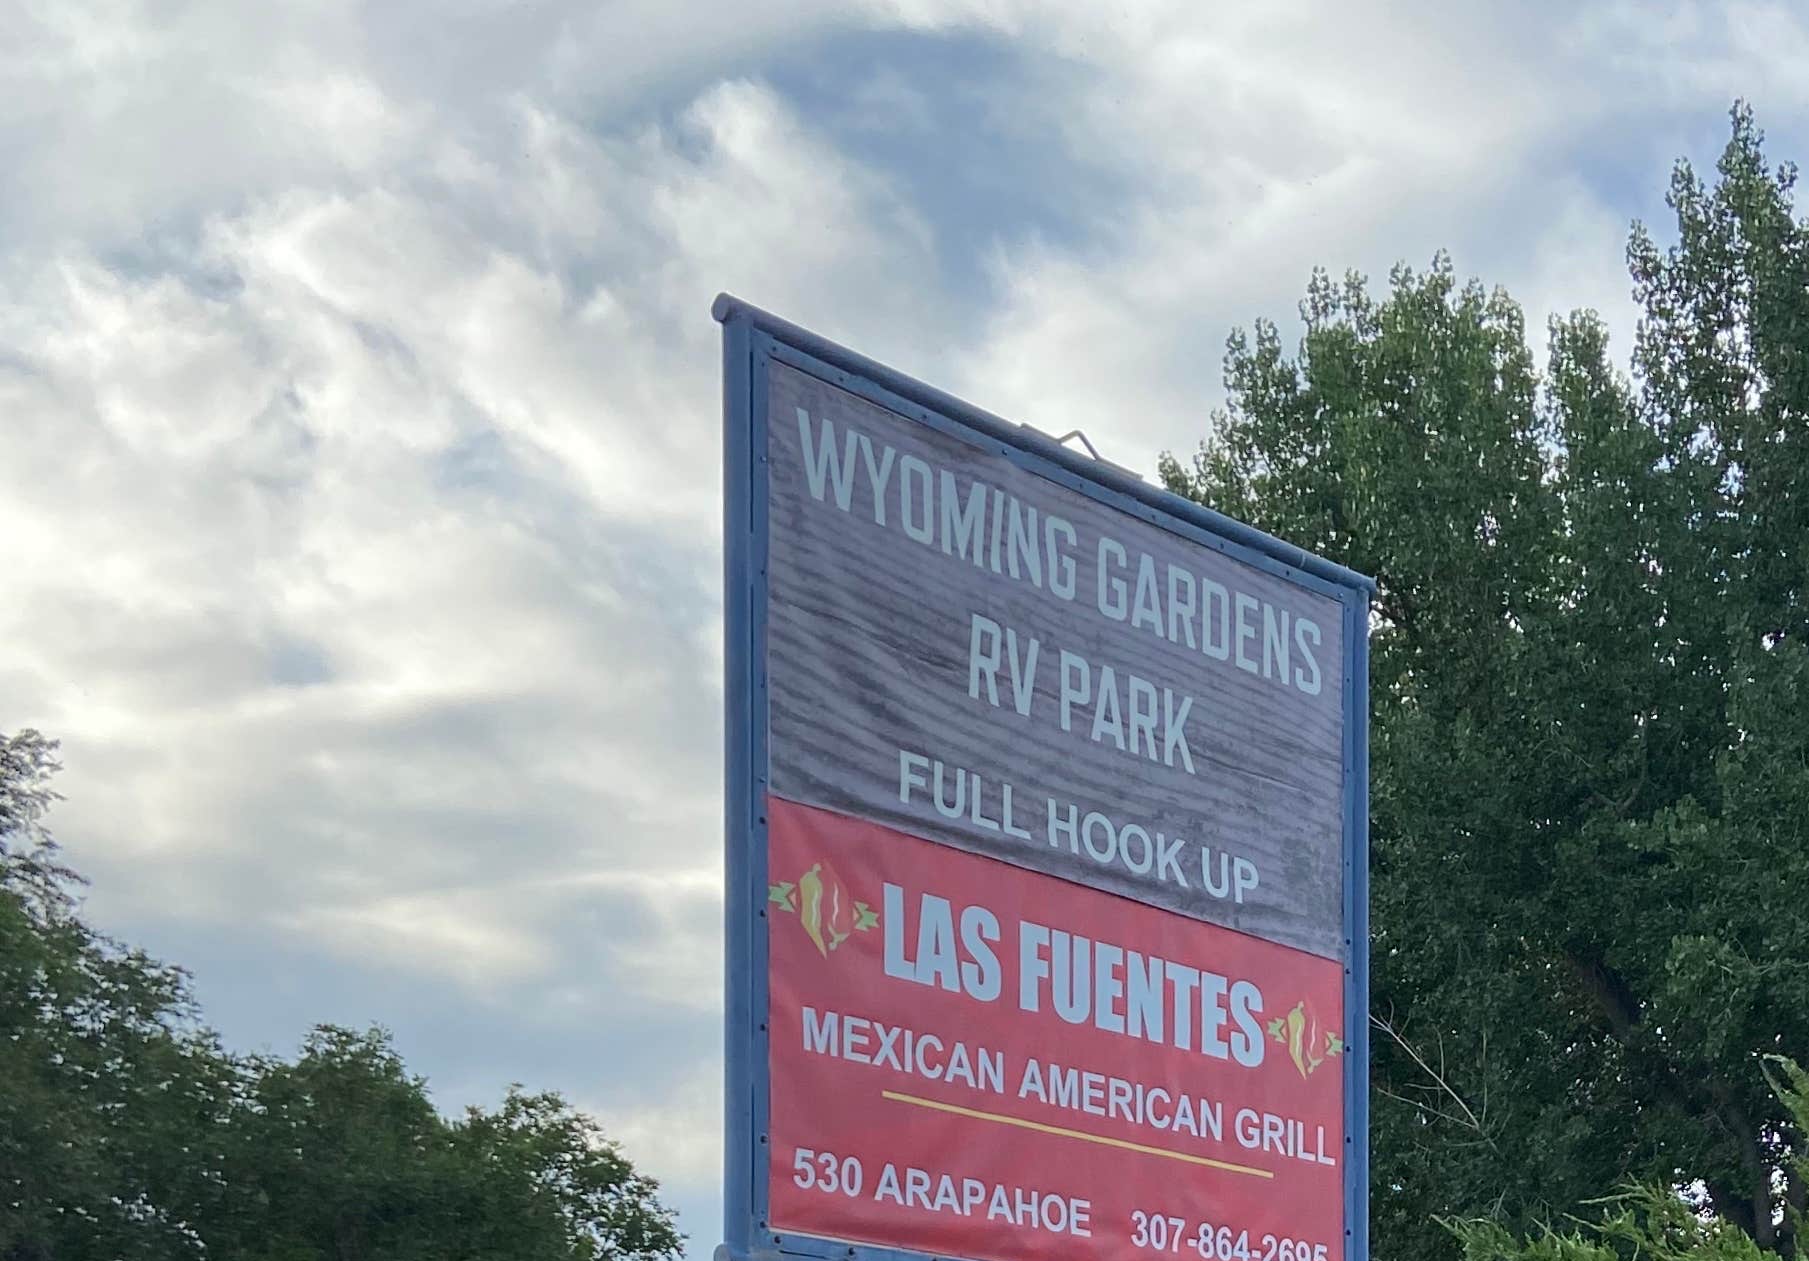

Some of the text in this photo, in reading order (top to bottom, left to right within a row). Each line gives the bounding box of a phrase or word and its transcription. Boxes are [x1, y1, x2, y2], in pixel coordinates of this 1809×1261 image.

[796, 407, 1322, 696] WYOMING GARDENS
[968, 615, 1196, 774] RV PARK
[899, 750, 1259, 904] FULL HOOK UP
[883, 882, 1265, 1067] LAS FUENTES
[802, 1007, 1336, 1166] MEXICAN AMERICAN GRILL
[793, 1148, 862, 1197] 530
[874, 1163, 1091, 1238] ARAPAHOE
